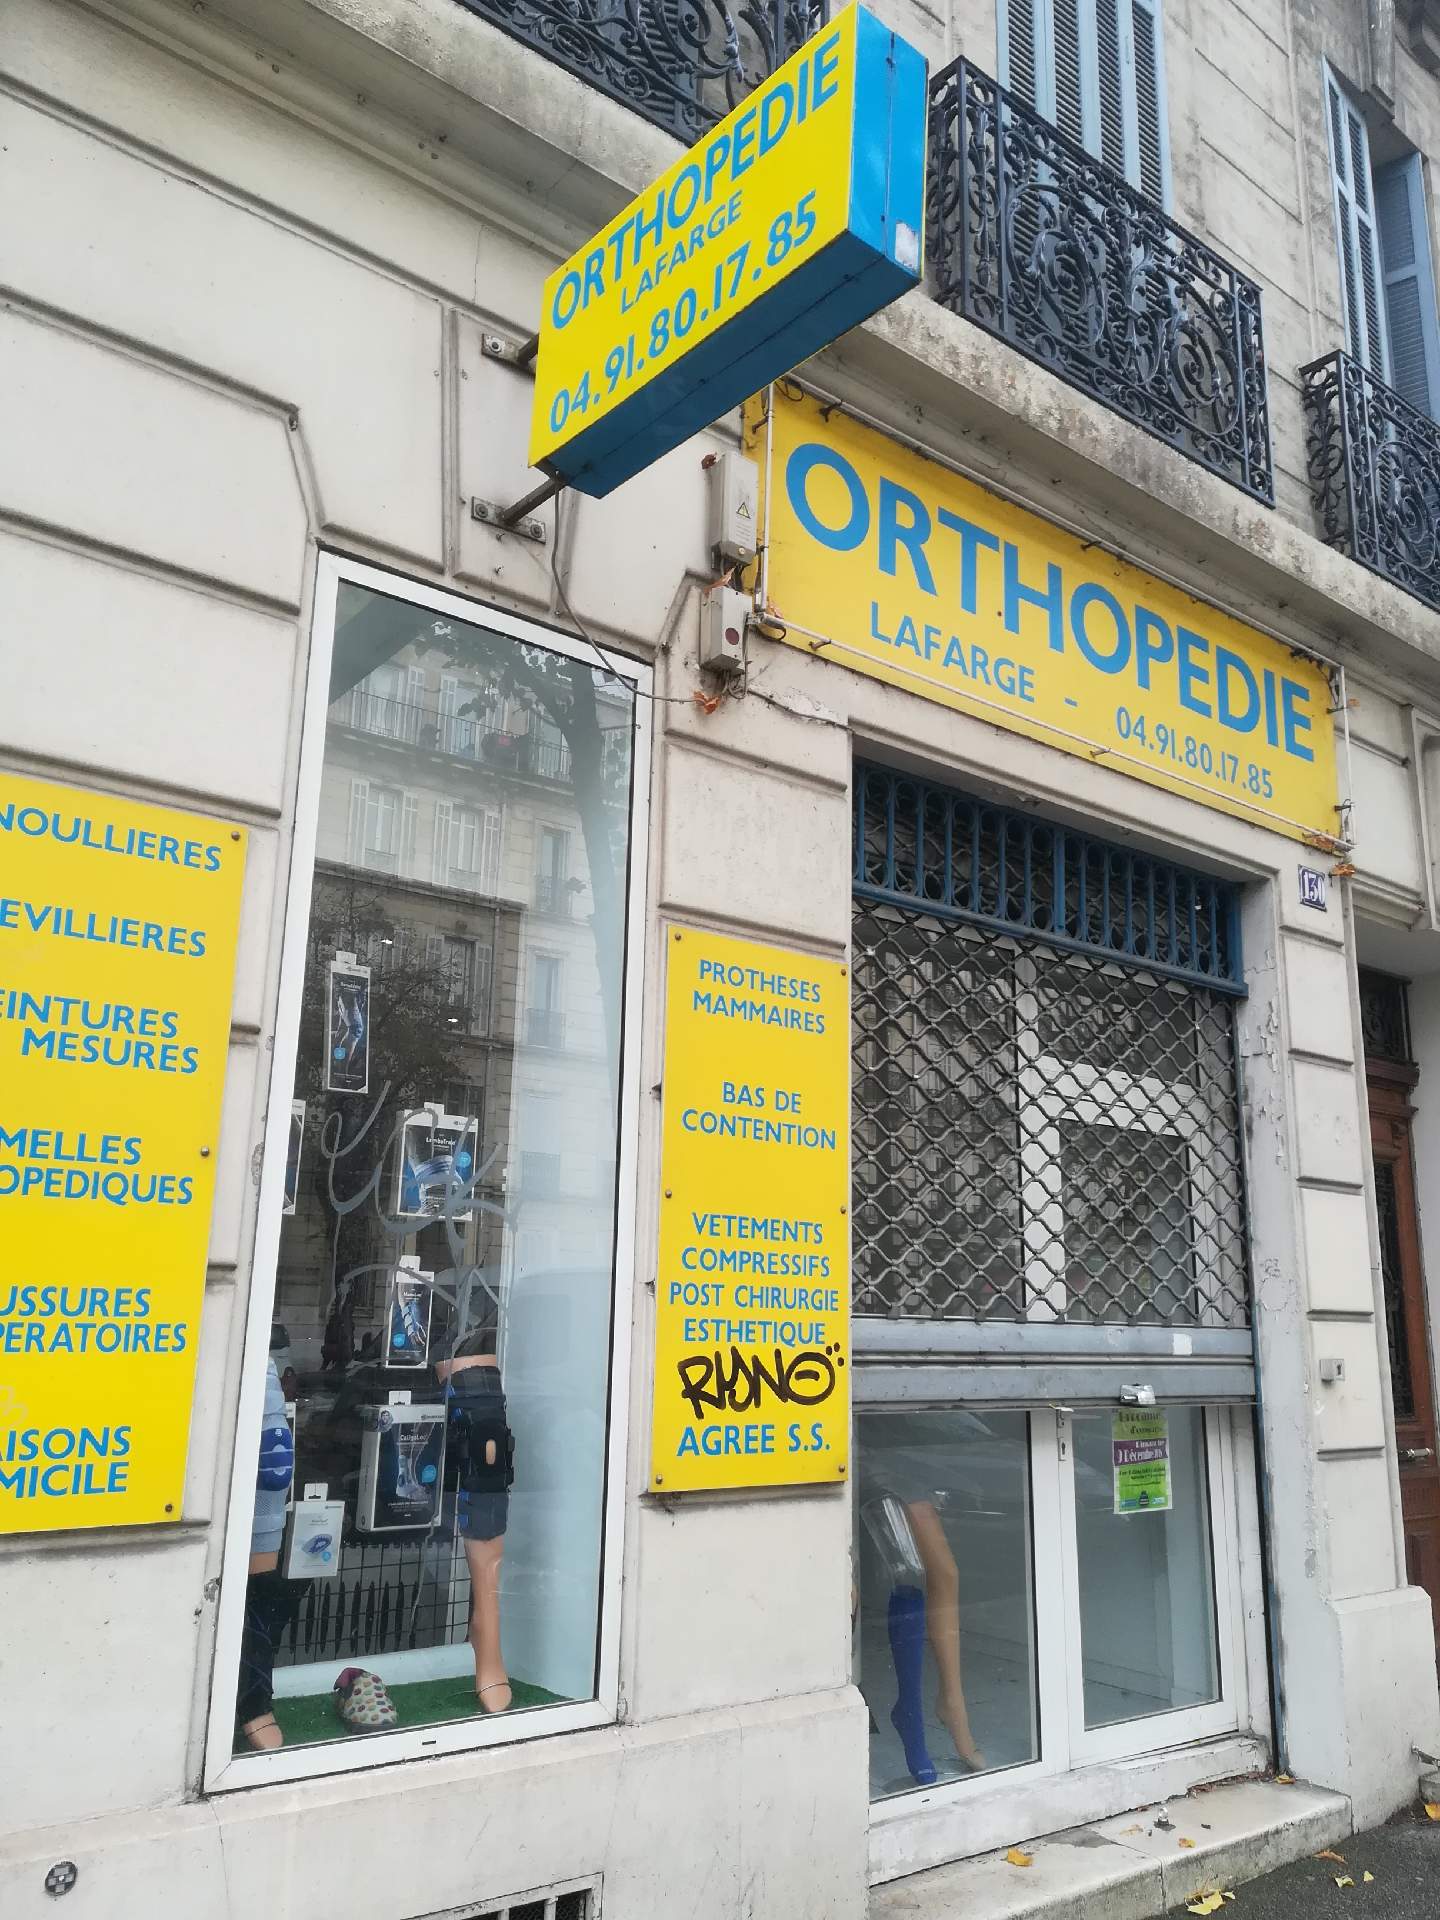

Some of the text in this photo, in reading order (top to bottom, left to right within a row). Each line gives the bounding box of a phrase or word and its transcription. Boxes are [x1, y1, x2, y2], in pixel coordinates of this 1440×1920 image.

[552, 31, 841, 330] ORTHOPEDIE
[620, 189, 743, 315] LAFARGE
[549, 190, 817, 434] 04.91.80.17.85
[785, 442, 1315, 762] ORTHOPEDIE
[870, 601, 1035, 703] LAFARGE
[1115, 706, 1274, 799] 04.91.80.17.85
[1303, 870, 1326, 905] 130
[0, 898, 206, 957] EVILLIERES
[699, 959, 821, 1003] PROTHESES
[693, 990, 825, 1034] MAMMAIRES
[21, 1027, 199, 1075] MESURES
[722, 1081, 802, 1114] BAS DE
[681, 1108, 836, 1150] CONTENTION
[692, 1212, 824, 1245] VETEMENTS
[681, 1246, 831, 1278] COMPRESSIFS
[669, 1282, 840, 1312] POST CHIRURGIE
[683, 1317, 826, 1348] ESTHETIQUE
[0, 1425, 132, 1461] ISONS
[676, 1421, 831, 1457] AGREE S.S.
